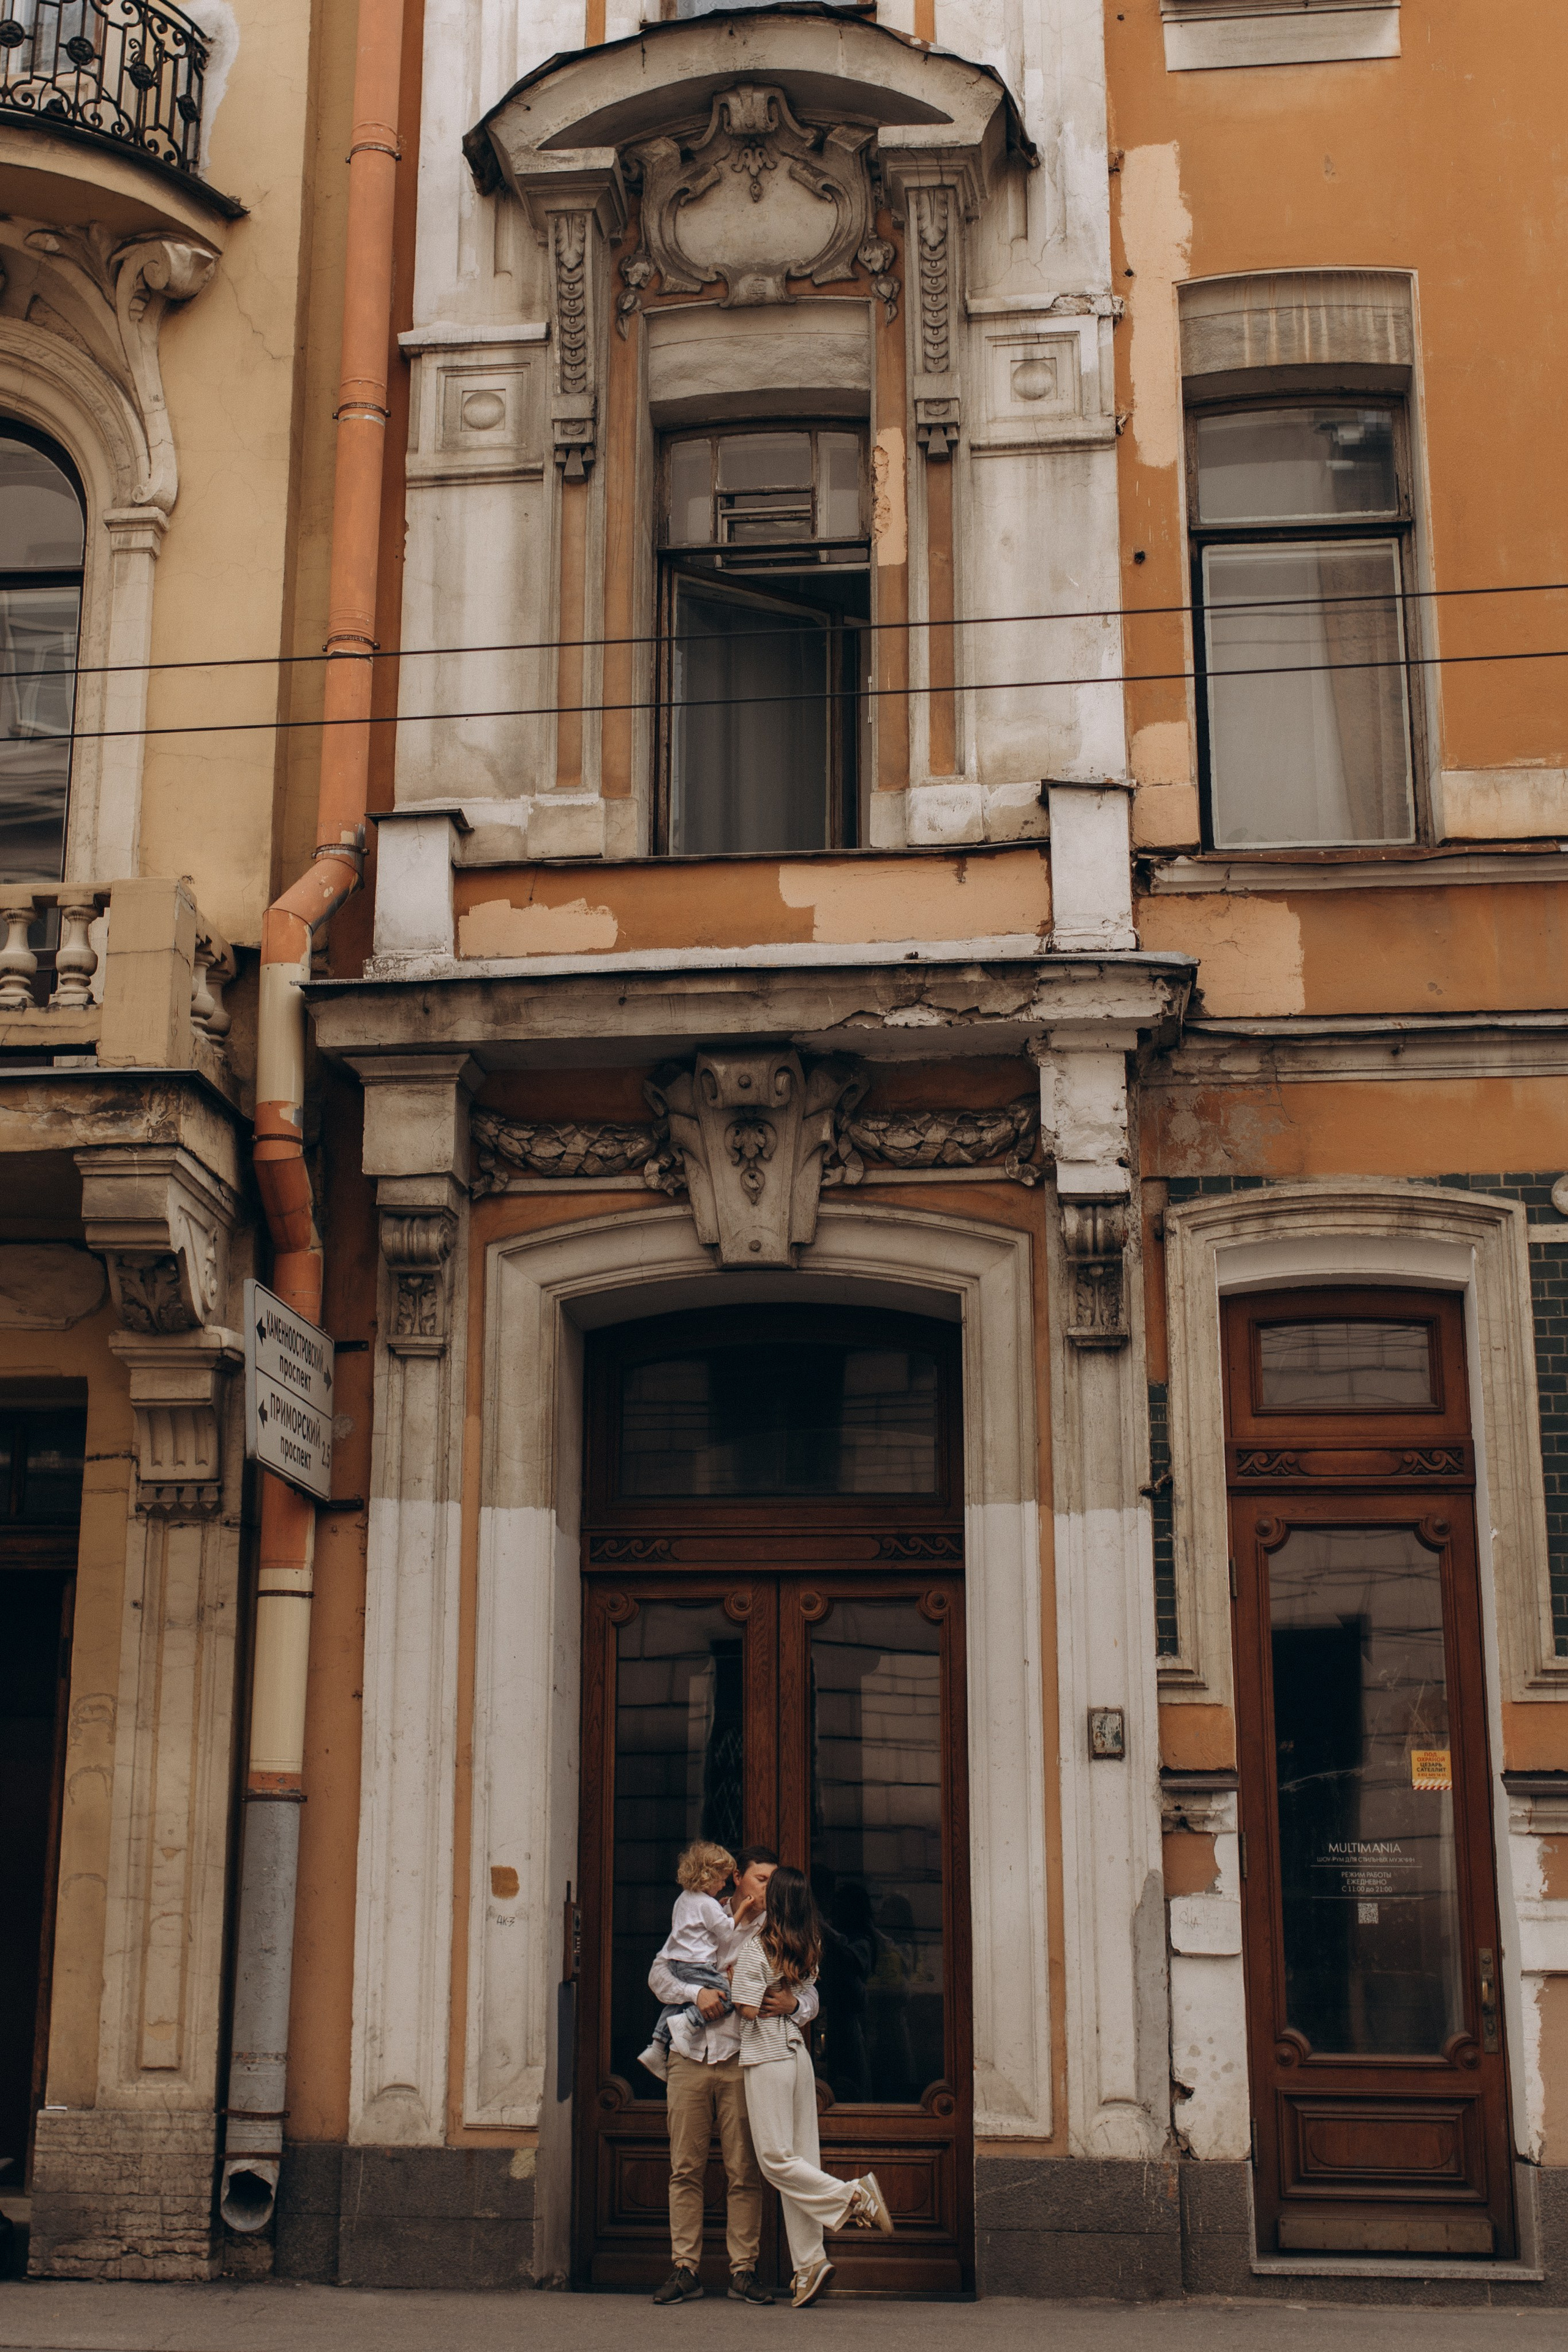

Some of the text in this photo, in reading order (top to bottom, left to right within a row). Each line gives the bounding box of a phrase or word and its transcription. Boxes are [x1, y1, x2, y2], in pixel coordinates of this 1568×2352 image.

[266, 1309, 324, 1375] КАМЕННООСТРОВСКИЙ
[279, 1354, 311, 1393] проспект
[270, 1392, 320, 1450] ПРИМОРСКИЙ
[281, 1436, 311, 1471] проспект
[1329, 1842, 1401, 1853] MULTIMANIA
[866, 2199, 879, 2217] N
[797, 2276, 809, 2288] N
